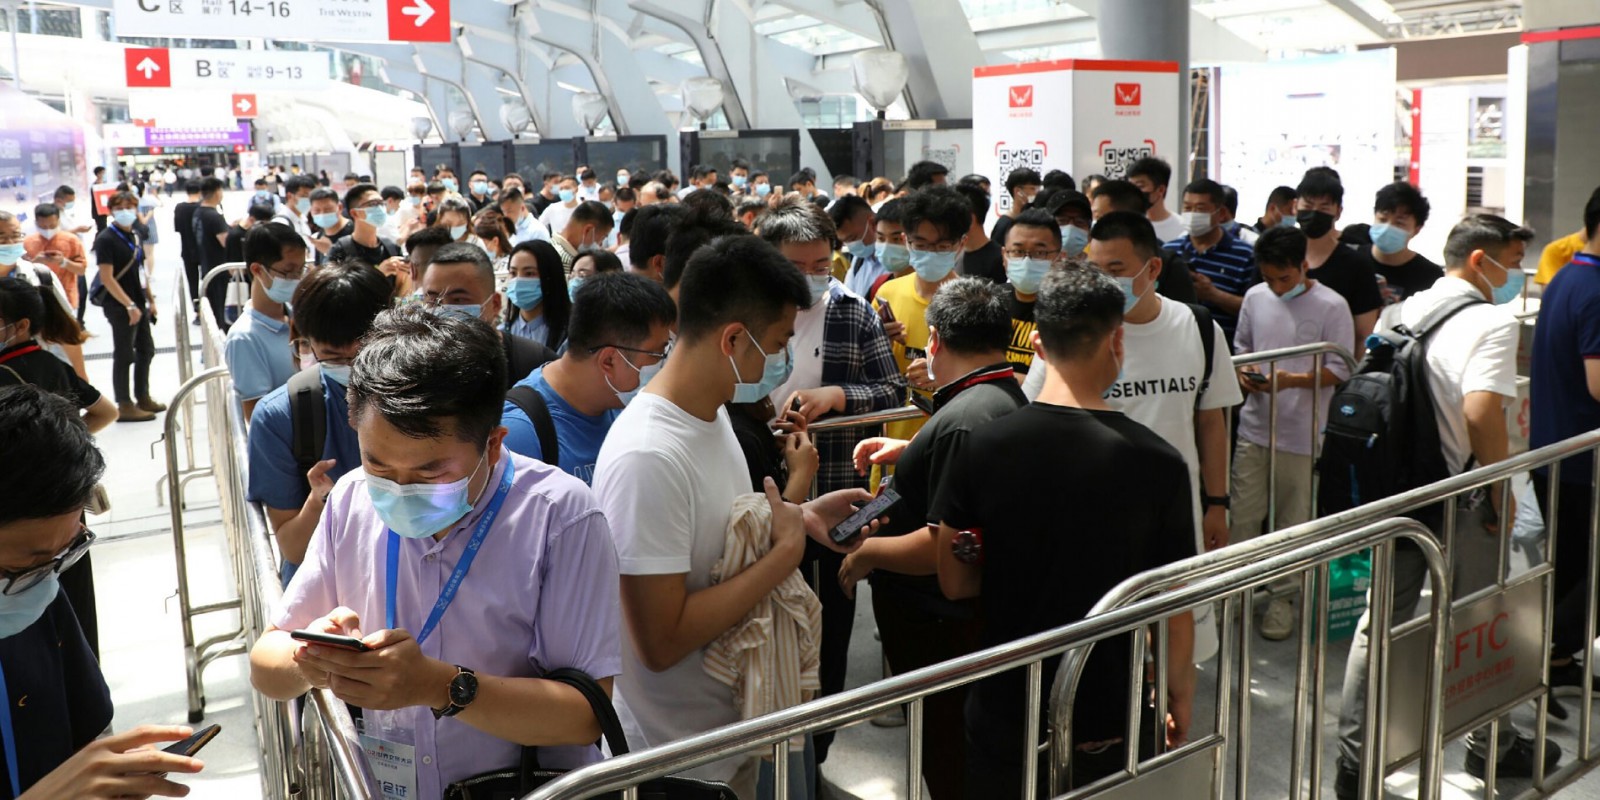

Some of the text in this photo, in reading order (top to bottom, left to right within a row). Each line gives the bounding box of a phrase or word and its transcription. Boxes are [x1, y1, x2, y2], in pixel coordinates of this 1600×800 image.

[228, 0, 290, 18] 14-16
[195, 59, 212, 78] B
[265, 66, 303, 80] 9-13
[1446, 611, 1509, 672] FTC
